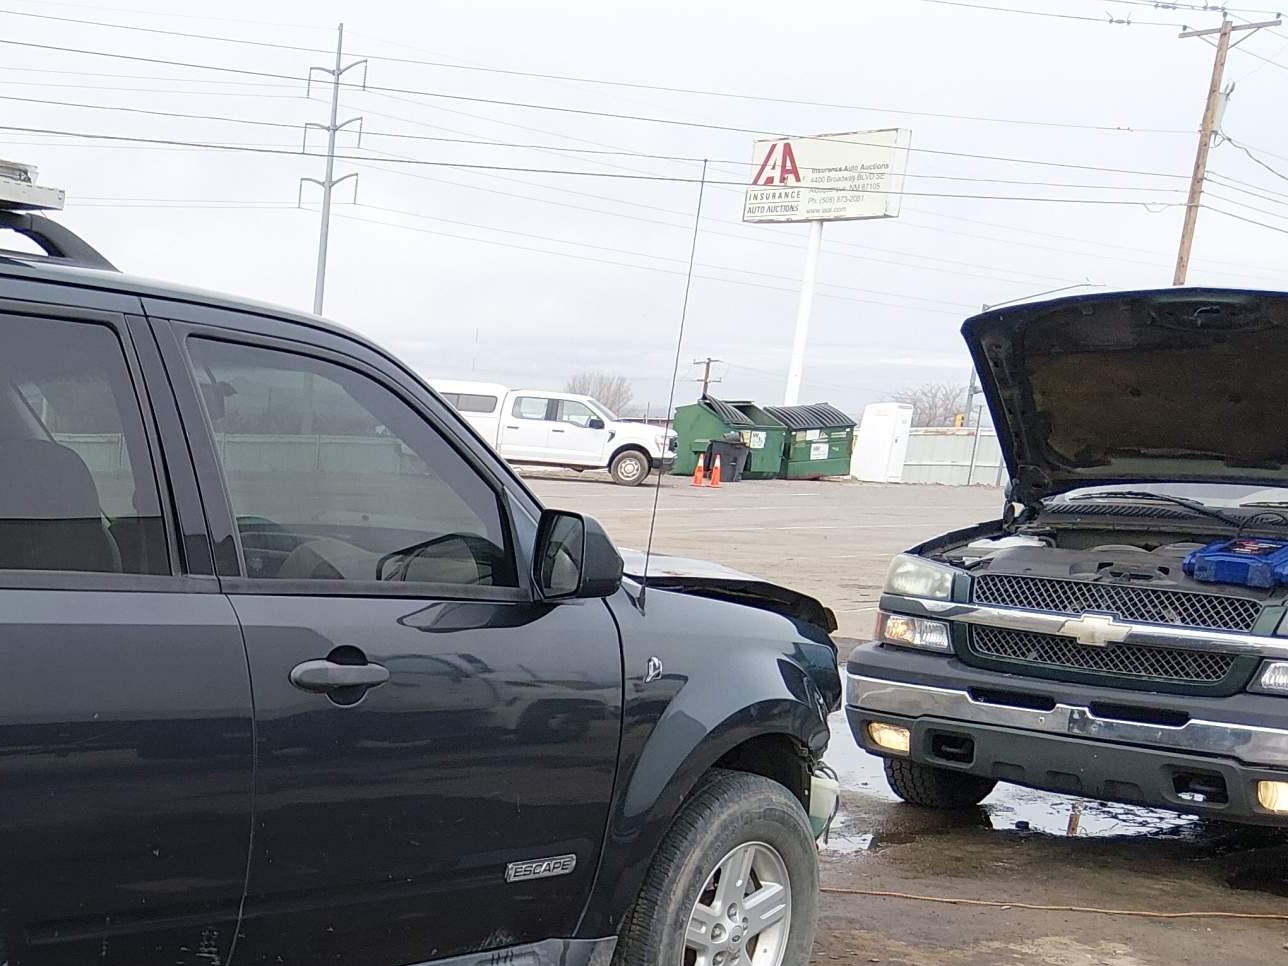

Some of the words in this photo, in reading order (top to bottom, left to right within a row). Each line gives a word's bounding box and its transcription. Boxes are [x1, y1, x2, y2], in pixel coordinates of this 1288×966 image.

[749, 190, 801, 201] INSURANCE
[747, 205, 765, 214] AUTO
[766, 204, 799, 213] AUCTIONS
[514, 860, 572, 877] ESCAPE
